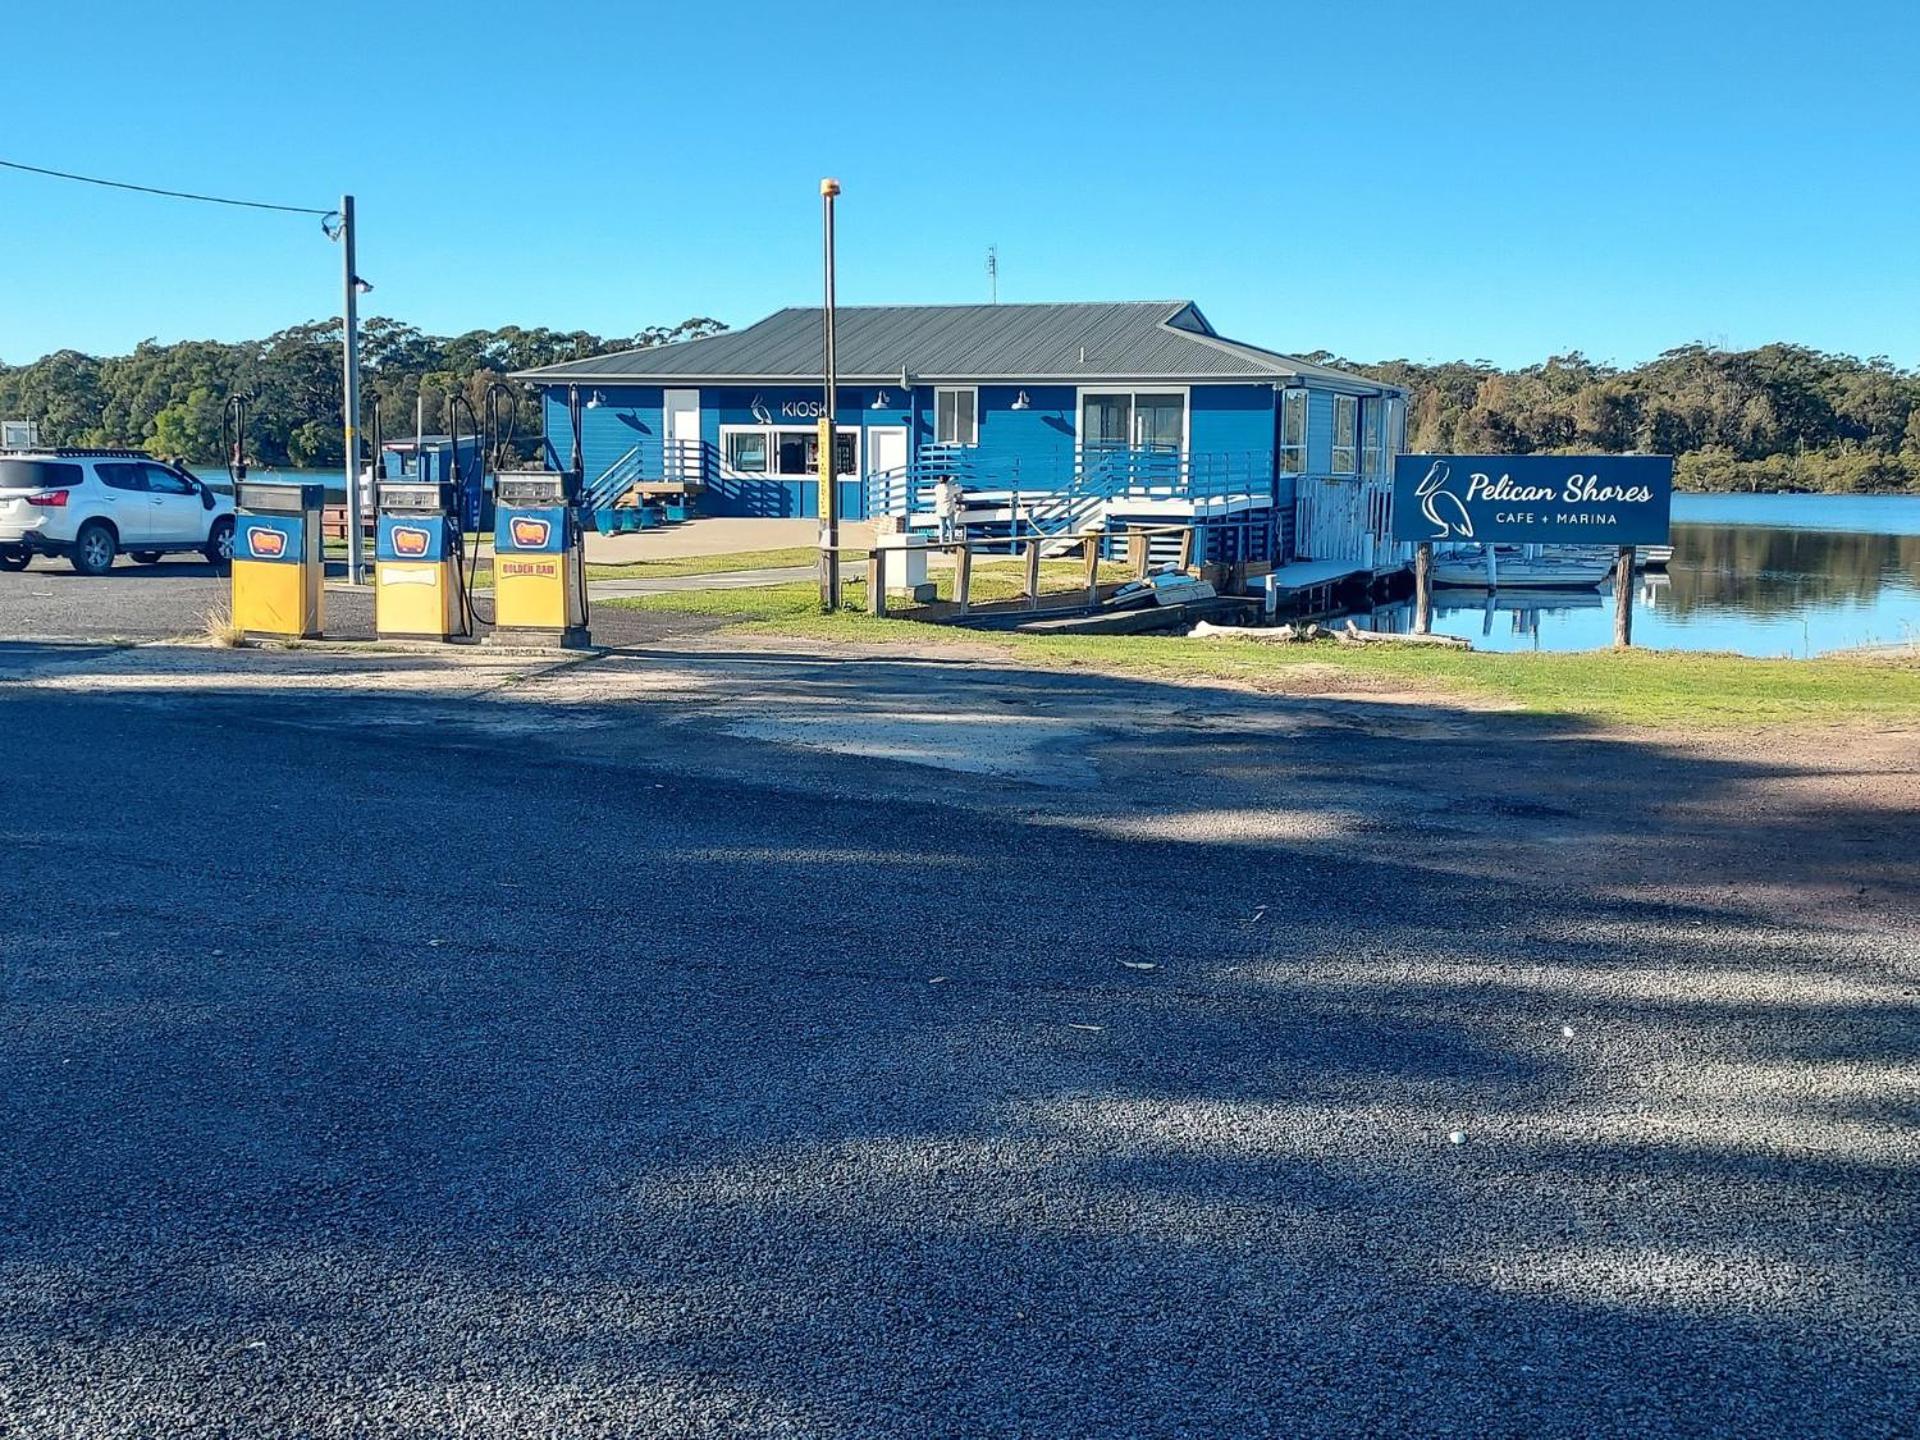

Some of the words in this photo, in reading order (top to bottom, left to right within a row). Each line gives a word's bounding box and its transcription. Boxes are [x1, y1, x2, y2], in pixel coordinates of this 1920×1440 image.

[782, 401, 828, 417] KIOSK
[1466, 473, 1556, 502] Pelican
[1563, 474, 1653, 503] Shores
[1496, 512, 1534, 524] CAFE
[1557, 513, 1617, 525] MARINA
